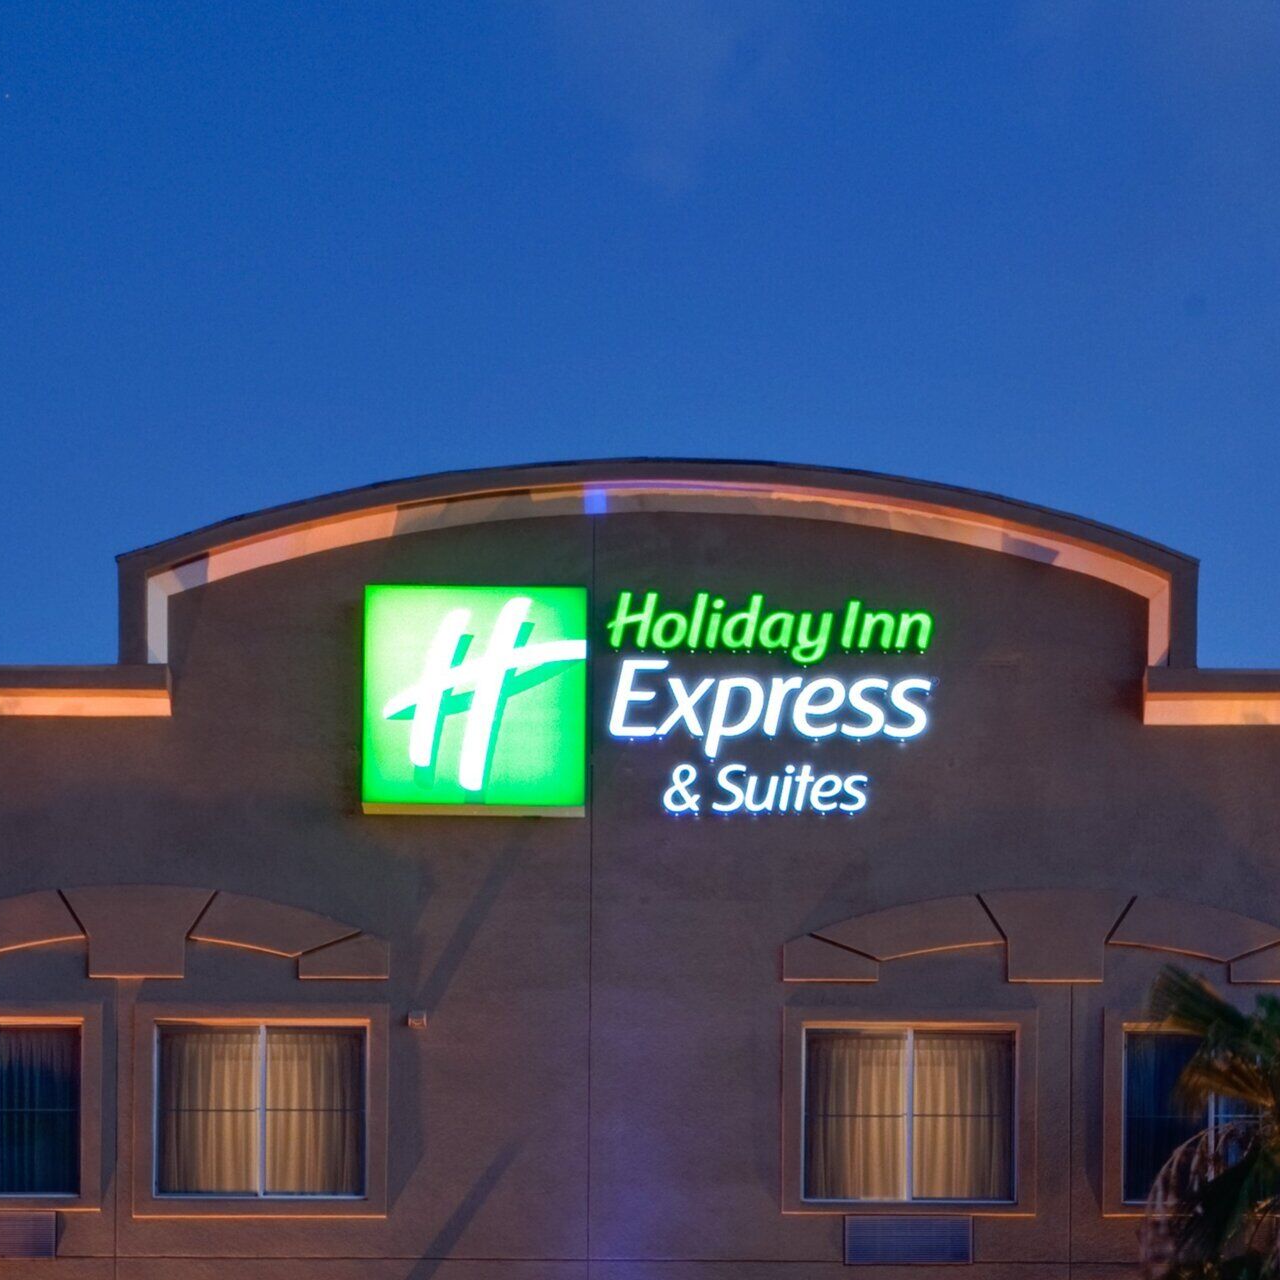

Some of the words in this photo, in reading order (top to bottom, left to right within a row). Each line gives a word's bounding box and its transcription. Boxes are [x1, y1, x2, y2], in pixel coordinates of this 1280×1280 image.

[606, 591, 833, 664] Holiday
[840, 600, 933, 650] Inn
[608, 658, 933, 758] Express
[662, 763, 701, 812] &
[711, 763, 869, 812] Suites
